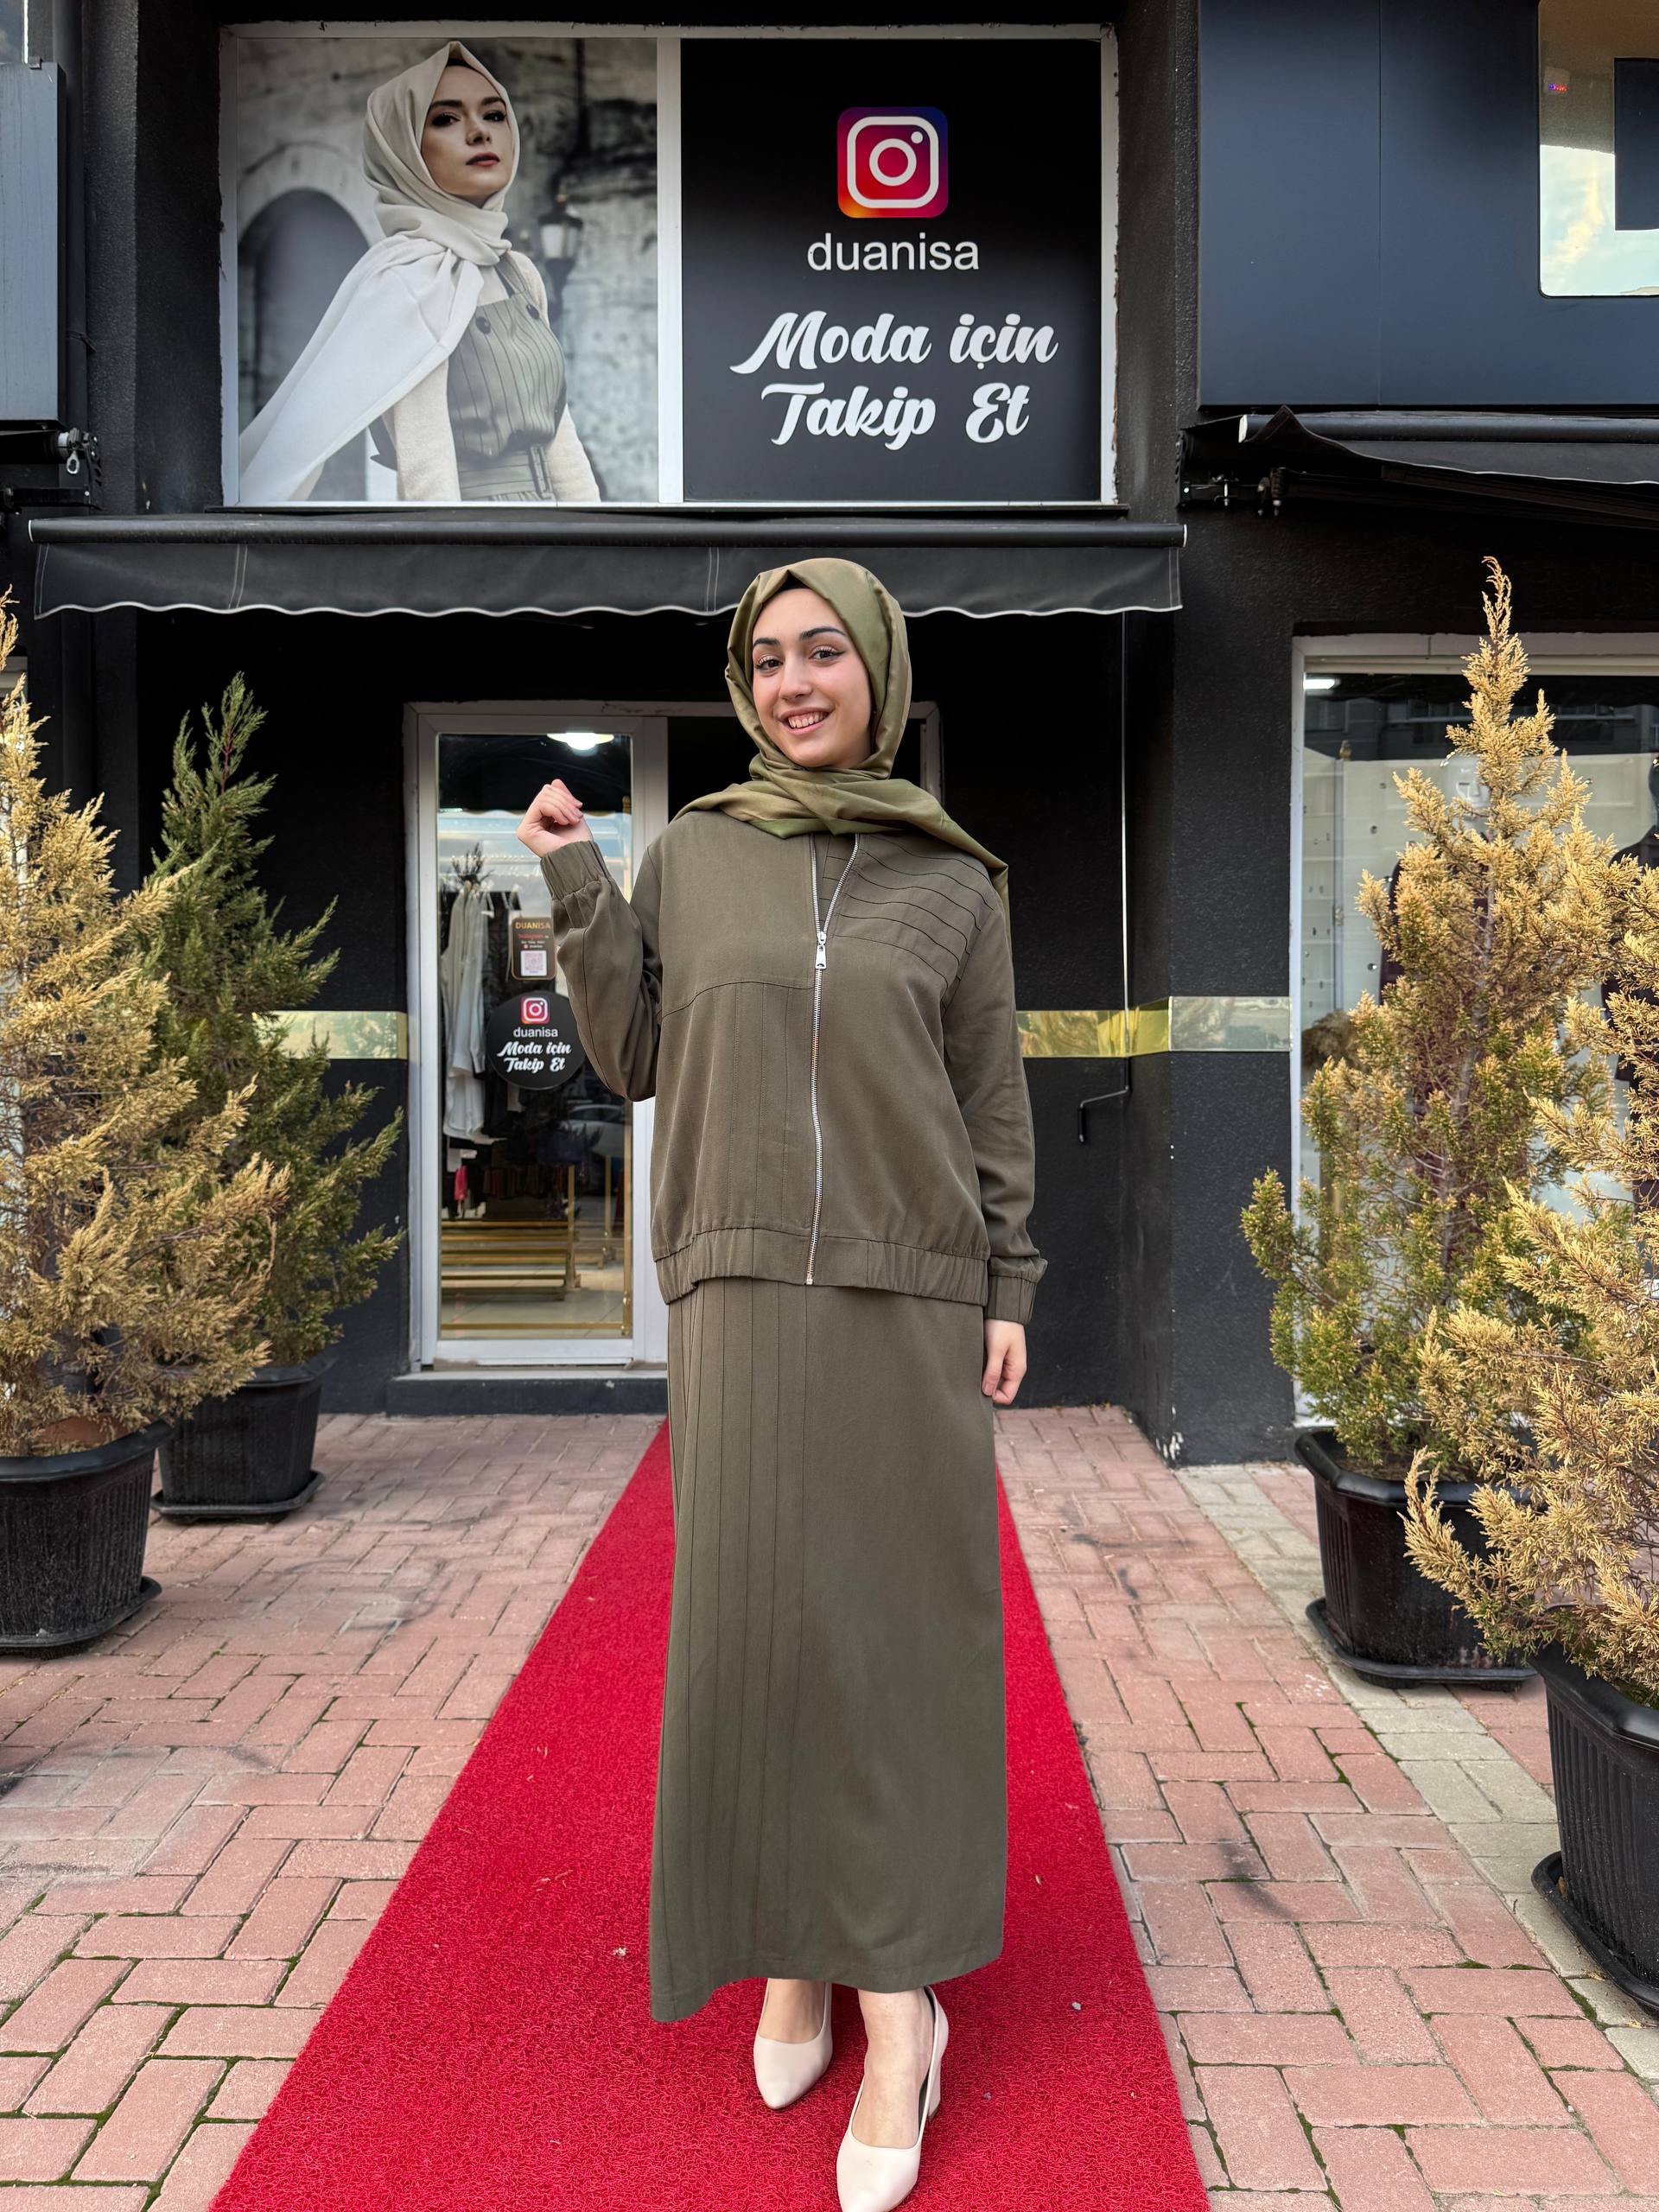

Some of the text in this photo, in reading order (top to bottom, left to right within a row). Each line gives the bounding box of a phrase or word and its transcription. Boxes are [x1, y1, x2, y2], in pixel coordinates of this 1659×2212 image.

[807, 232, 979, 270] duanisa
[730, 310, 1058, 374] Moda için
[761, 382, 1030, 450] Takip Et
[513, 1027, 558, 1038] duanisa
[497, 1041, 572, 1057] Moda için
[504, 1057, 565, 1074] Takip Et
